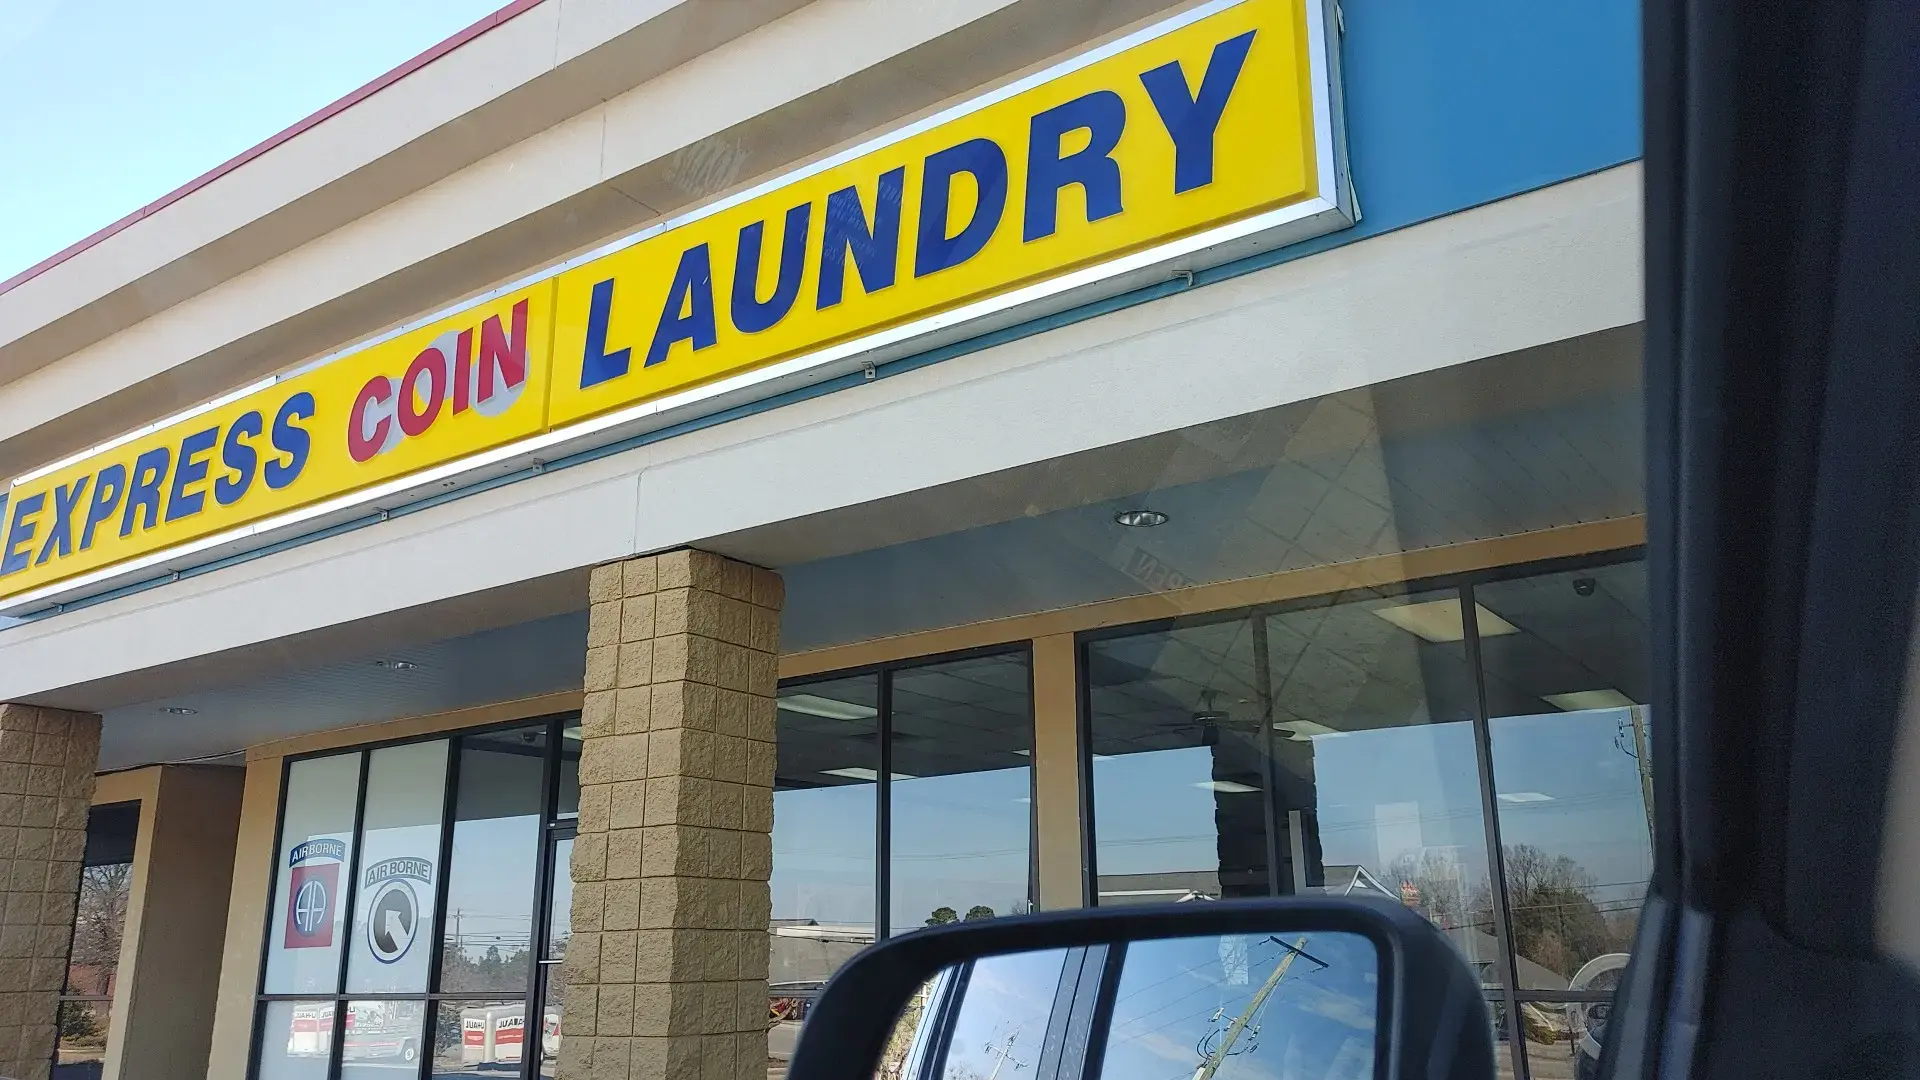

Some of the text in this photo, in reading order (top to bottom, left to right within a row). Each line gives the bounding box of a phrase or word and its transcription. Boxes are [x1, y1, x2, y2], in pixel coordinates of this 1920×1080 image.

[0, 391, 316, 577] EXPRESS
[347, 298, 529, 463] COIN
[579, 28, 1257, 390] LAUNDRY
[292, 843, 342, 862] AIRBORNE
